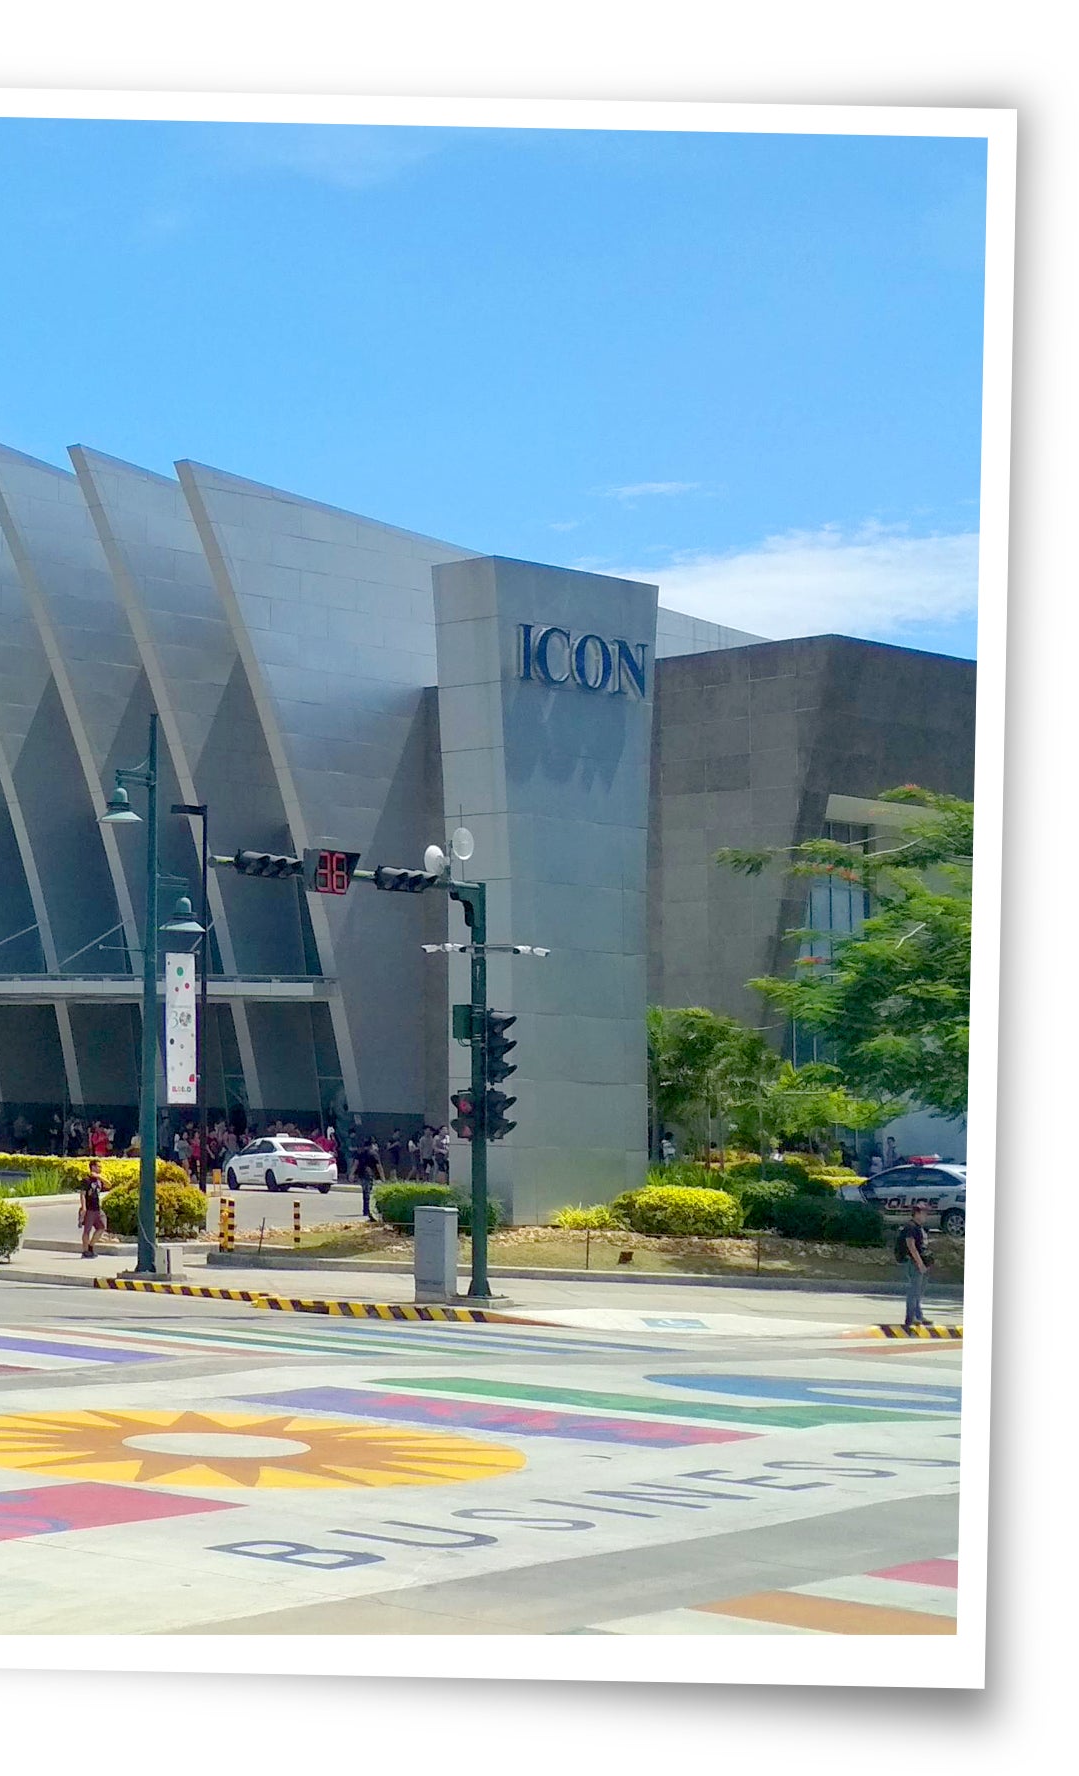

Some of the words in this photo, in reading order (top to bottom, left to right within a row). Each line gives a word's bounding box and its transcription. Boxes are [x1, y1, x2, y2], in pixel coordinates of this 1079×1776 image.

[516, 622, 648, 699] ICON
[316, 851, 348, 894] 36
[207, 1451, 960, 1571] BUSINESS
